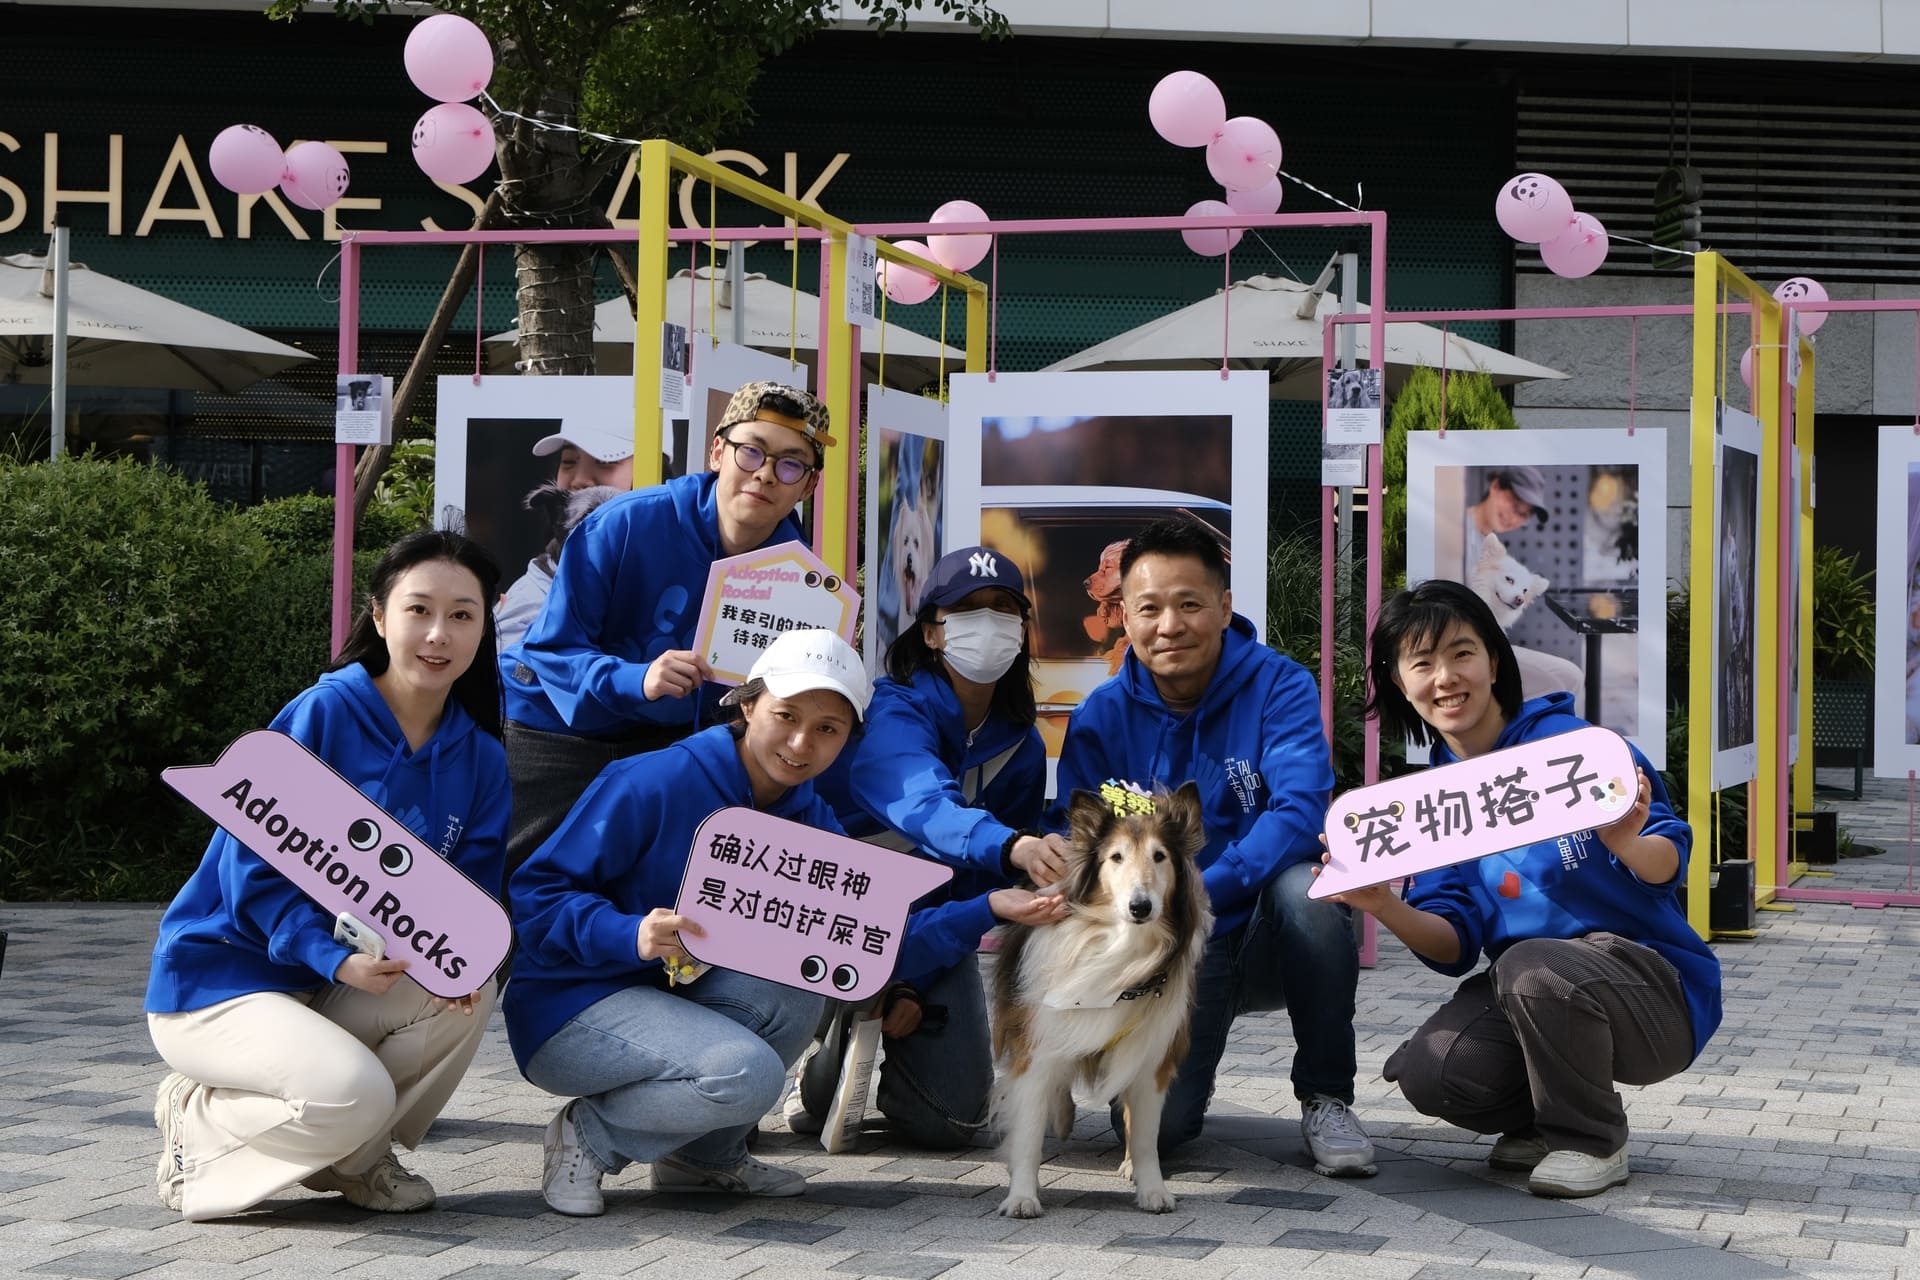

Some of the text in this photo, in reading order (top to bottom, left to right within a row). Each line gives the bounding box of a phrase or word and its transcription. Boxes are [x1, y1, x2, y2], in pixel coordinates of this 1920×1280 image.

[420, 148, 850, 251] ACK
[1253, 339, 1309, 347] SHAKE
[724, 566, 799, 584] Adoption
[969, 552, 998, 577] NY
[721, 584, 772, 600] Rocks!
[721, 604, 829, 633] 我牵引的狗
[733, 628, 778, 649] 待领
[1344, 754, 1598, 863] 宠物搭子
[221, 778, 468, 979] Adoption Rocks
[709, 833, 871, 901] 确认过眼神
[696, 877, 891, 956] 是对的铲屎官
